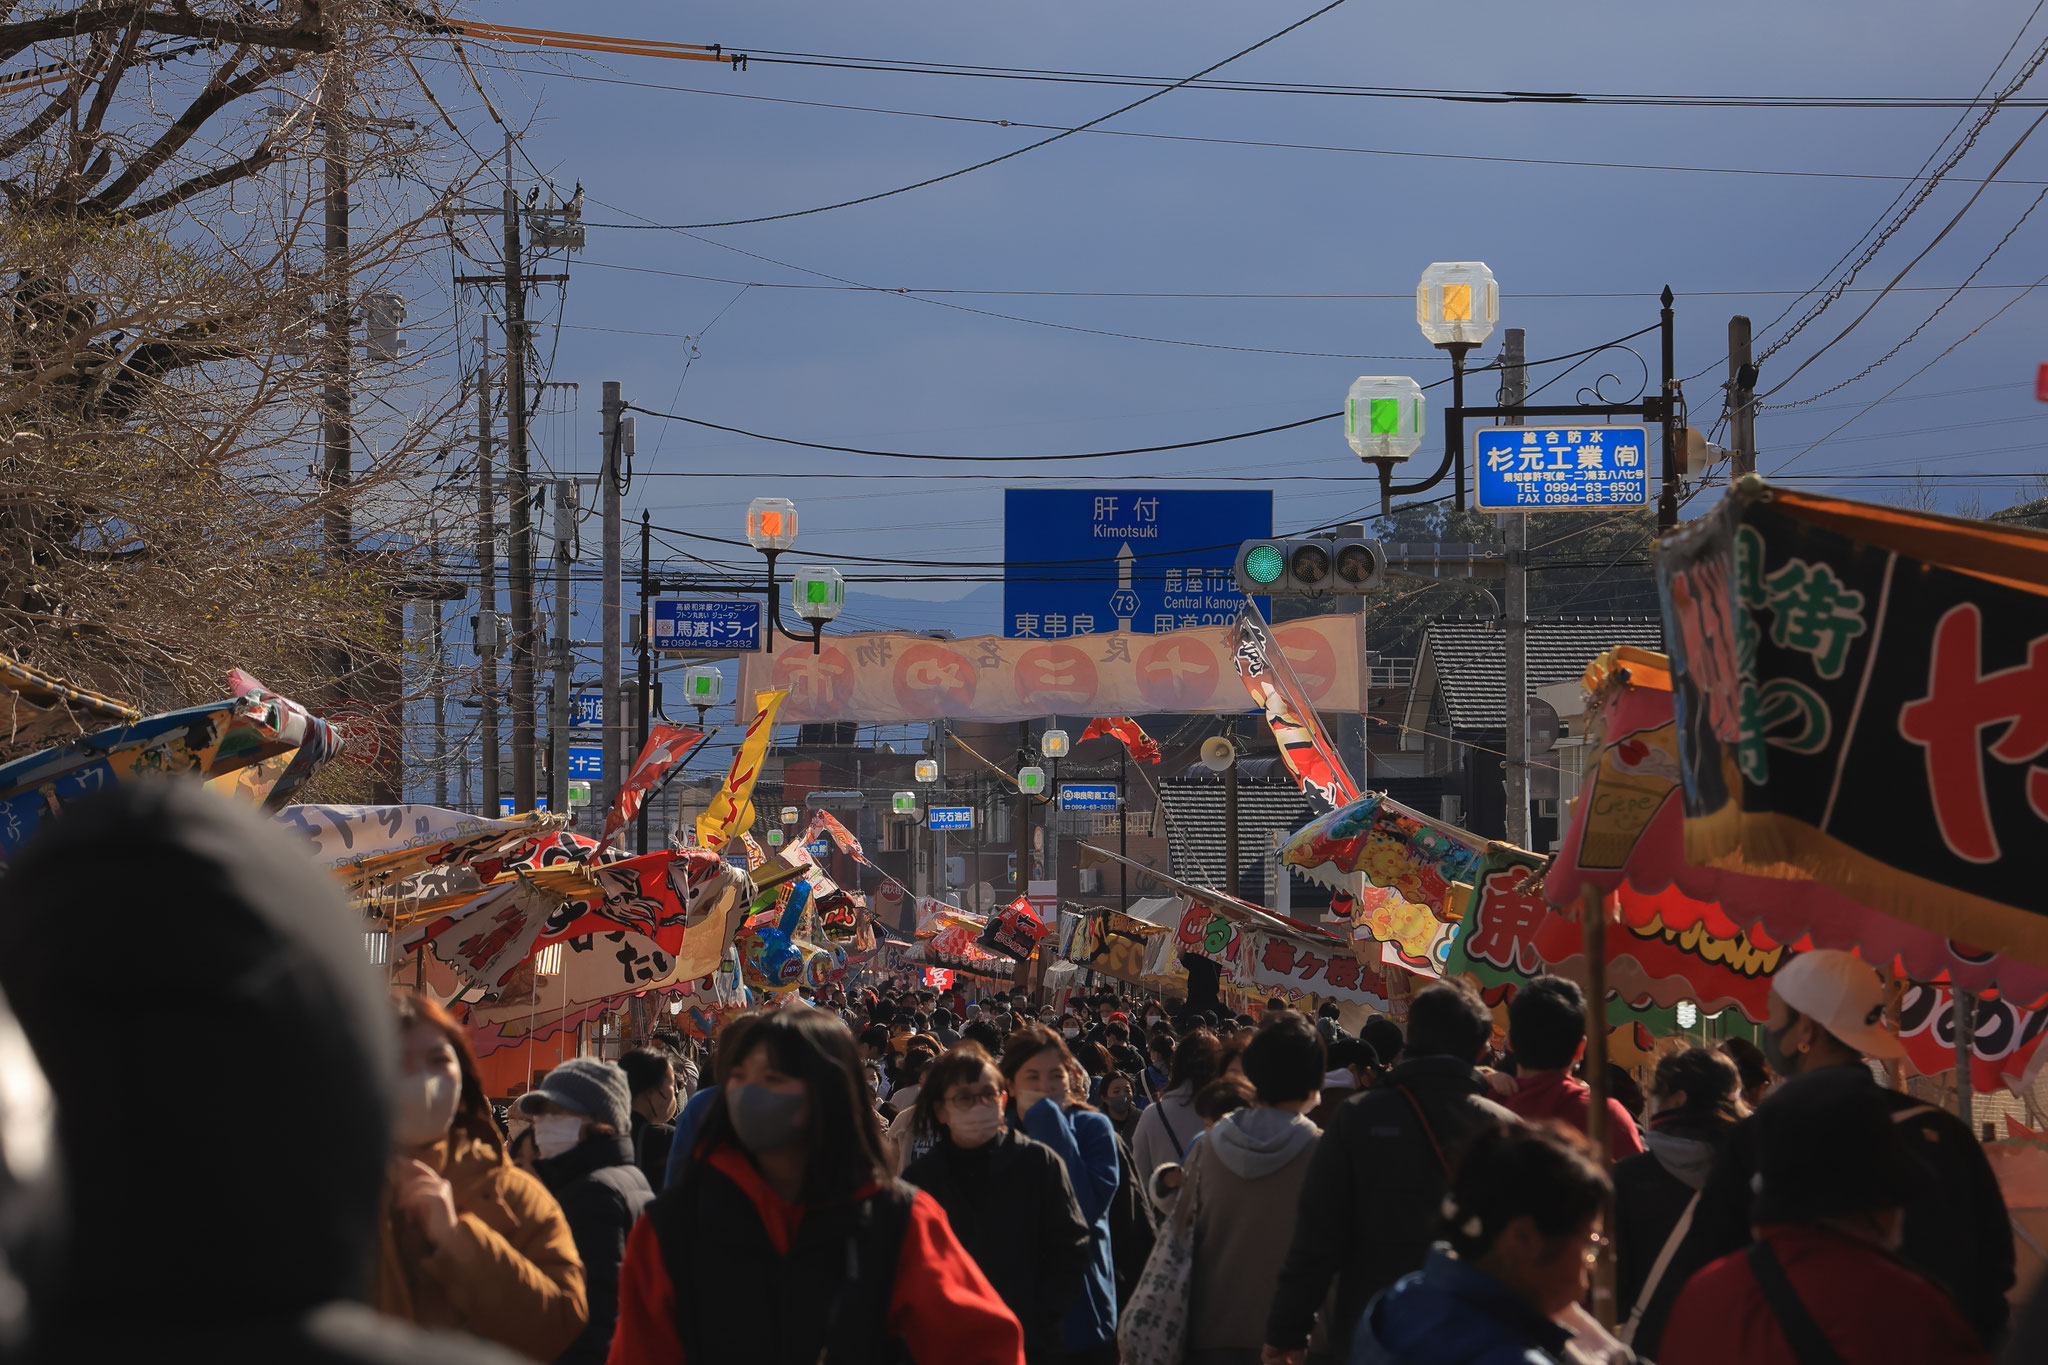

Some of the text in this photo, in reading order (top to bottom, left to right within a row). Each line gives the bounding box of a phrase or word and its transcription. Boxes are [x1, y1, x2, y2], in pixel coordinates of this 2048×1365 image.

[1523, 431, 1603, 444] 総合防水
[1486, 445, 1604, 472] 杉元工業
[1517, 482, 1641, 493] TEL 0994-63-6501
[1517, 492, 1643, 503] FAX 0994-63-3700
[1093, 496, 1160, 522] 肝付
[1093, 524, 1158, 538] Kimotsuki
[1116, 595, 1134, 611] 73
[1164, 596, 1245, 612] Central Kanoya
[676, 621, 758, 638] 馬渡ドライ
[1014, 612, 1095, 638] 東串良
[671, 639, 752, 648] 0994-63-2332
[930, 811, 970, 822] 山元石油店
[882, 884, 902, 895] 消火栓
